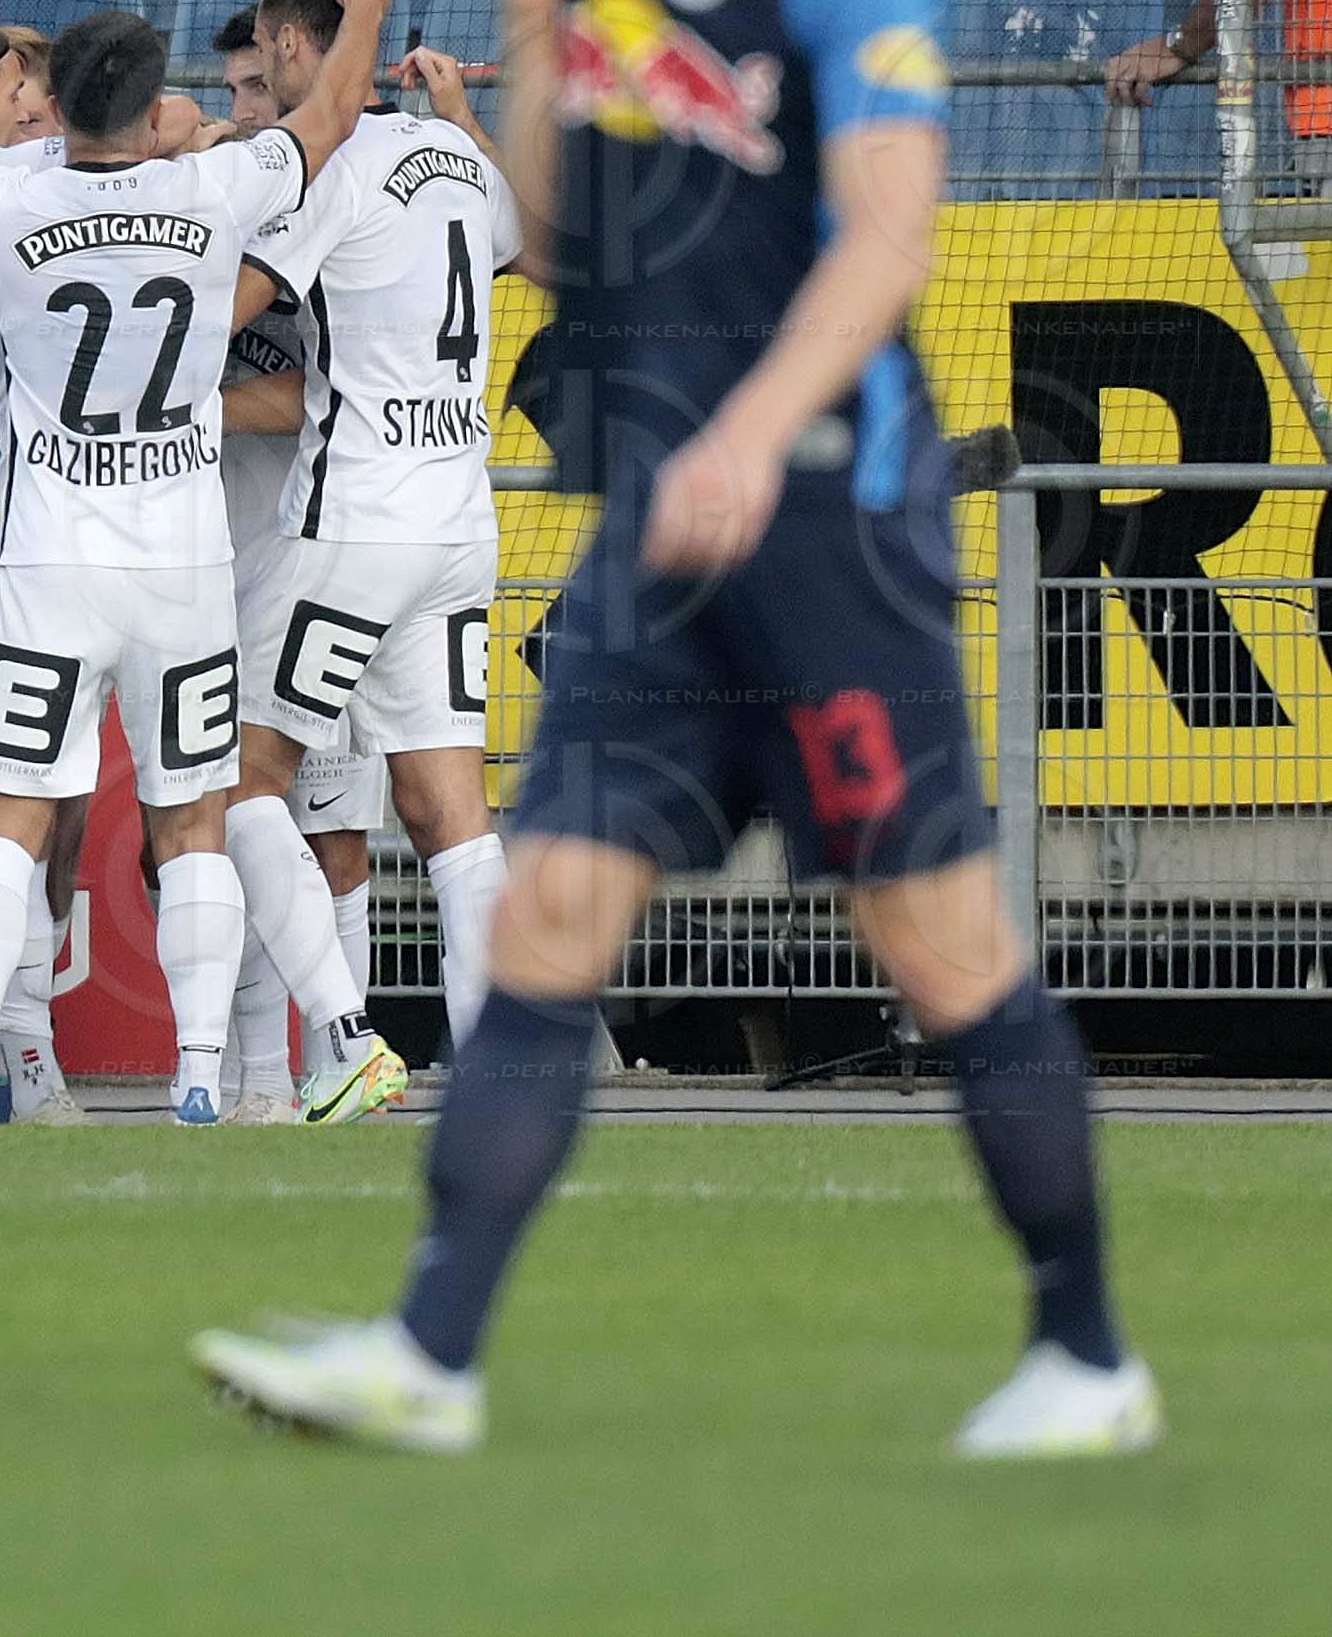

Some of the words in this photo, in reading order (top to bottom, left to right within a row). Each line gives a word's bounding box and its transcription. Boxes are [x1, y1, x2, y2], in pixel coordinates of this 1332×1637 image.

[28, 214, 208, 264] PUNTIGAMER
[436, 219, 479, 384] 4
[45, 275, 196, 437] 22
